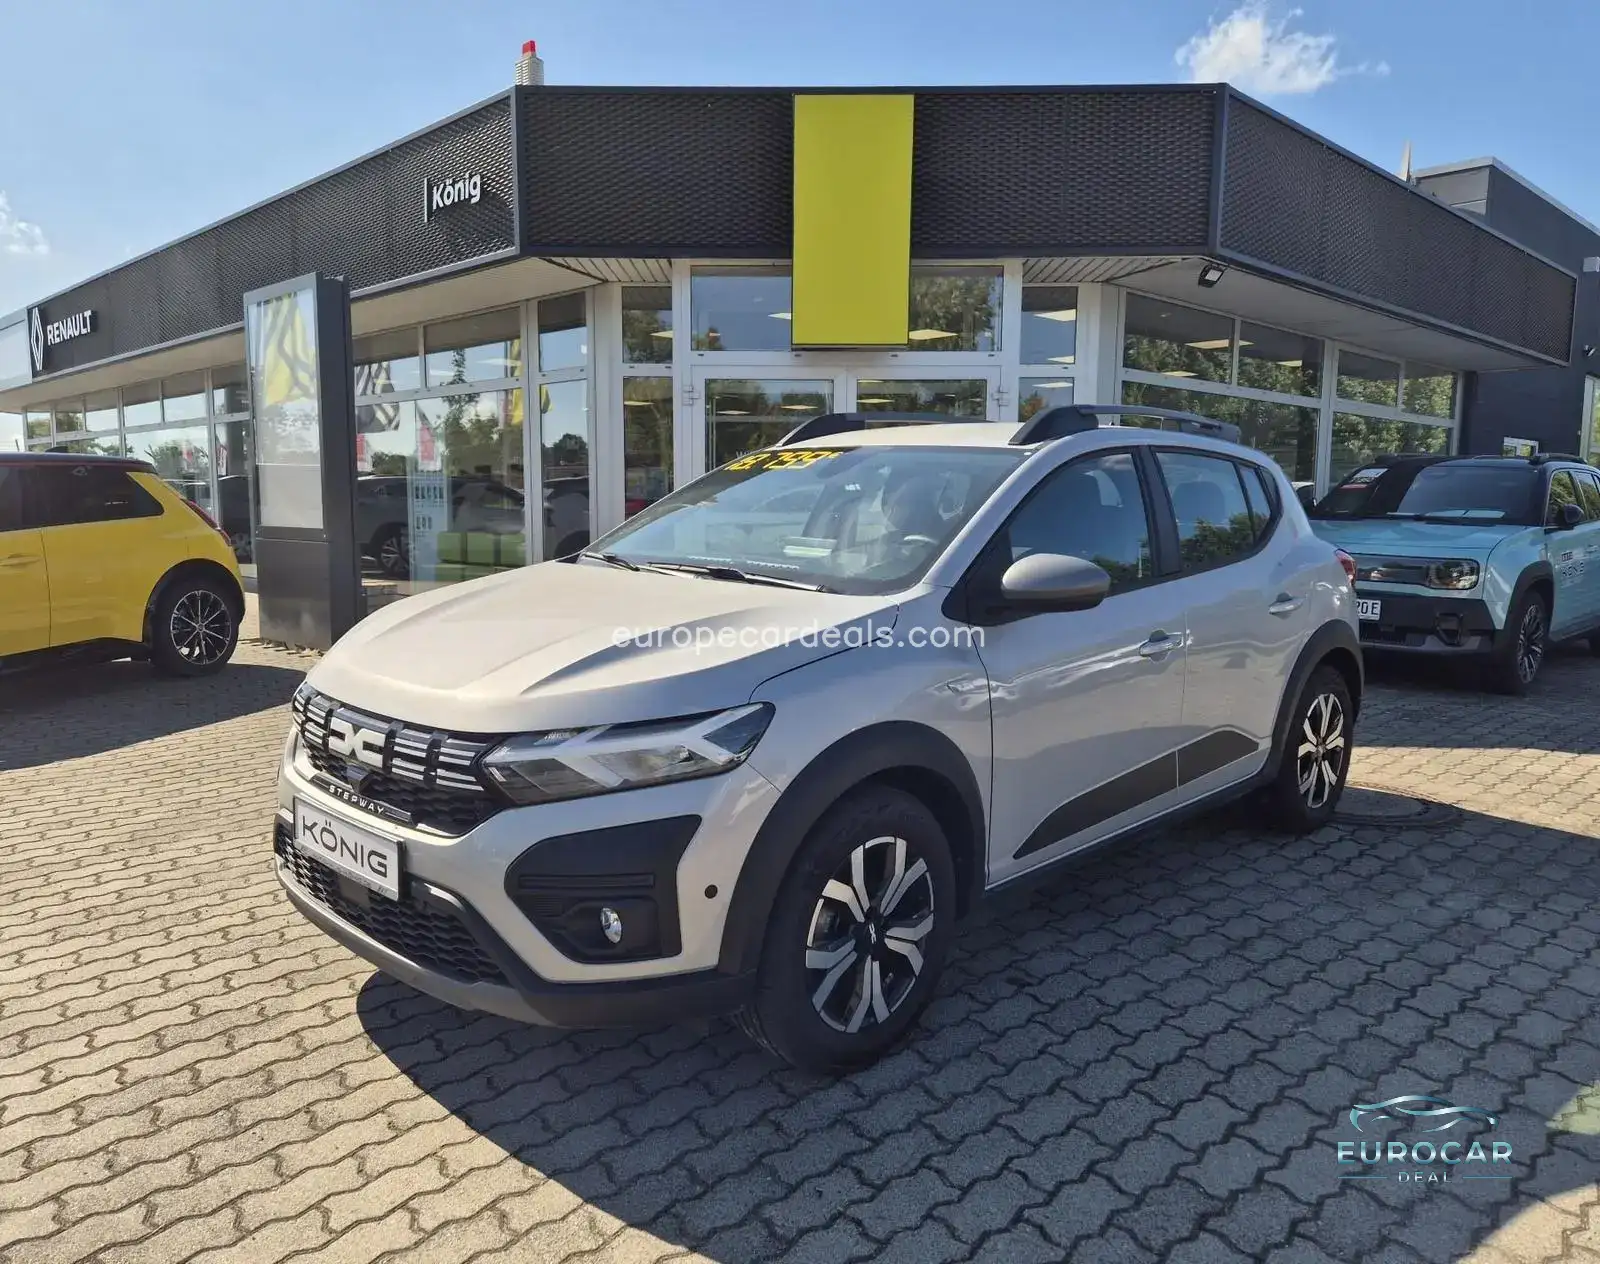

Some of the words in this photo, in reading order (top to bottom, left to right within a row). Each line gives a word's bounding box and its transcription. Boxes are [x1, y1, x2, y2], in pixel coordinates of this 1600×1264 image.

[432, 173, 481, 211] König
[46, 309, 92, 346] RENAULT
[328, 785, 385, 814] STEPWAY
[302, 815, 388, 879] KÖNIG
